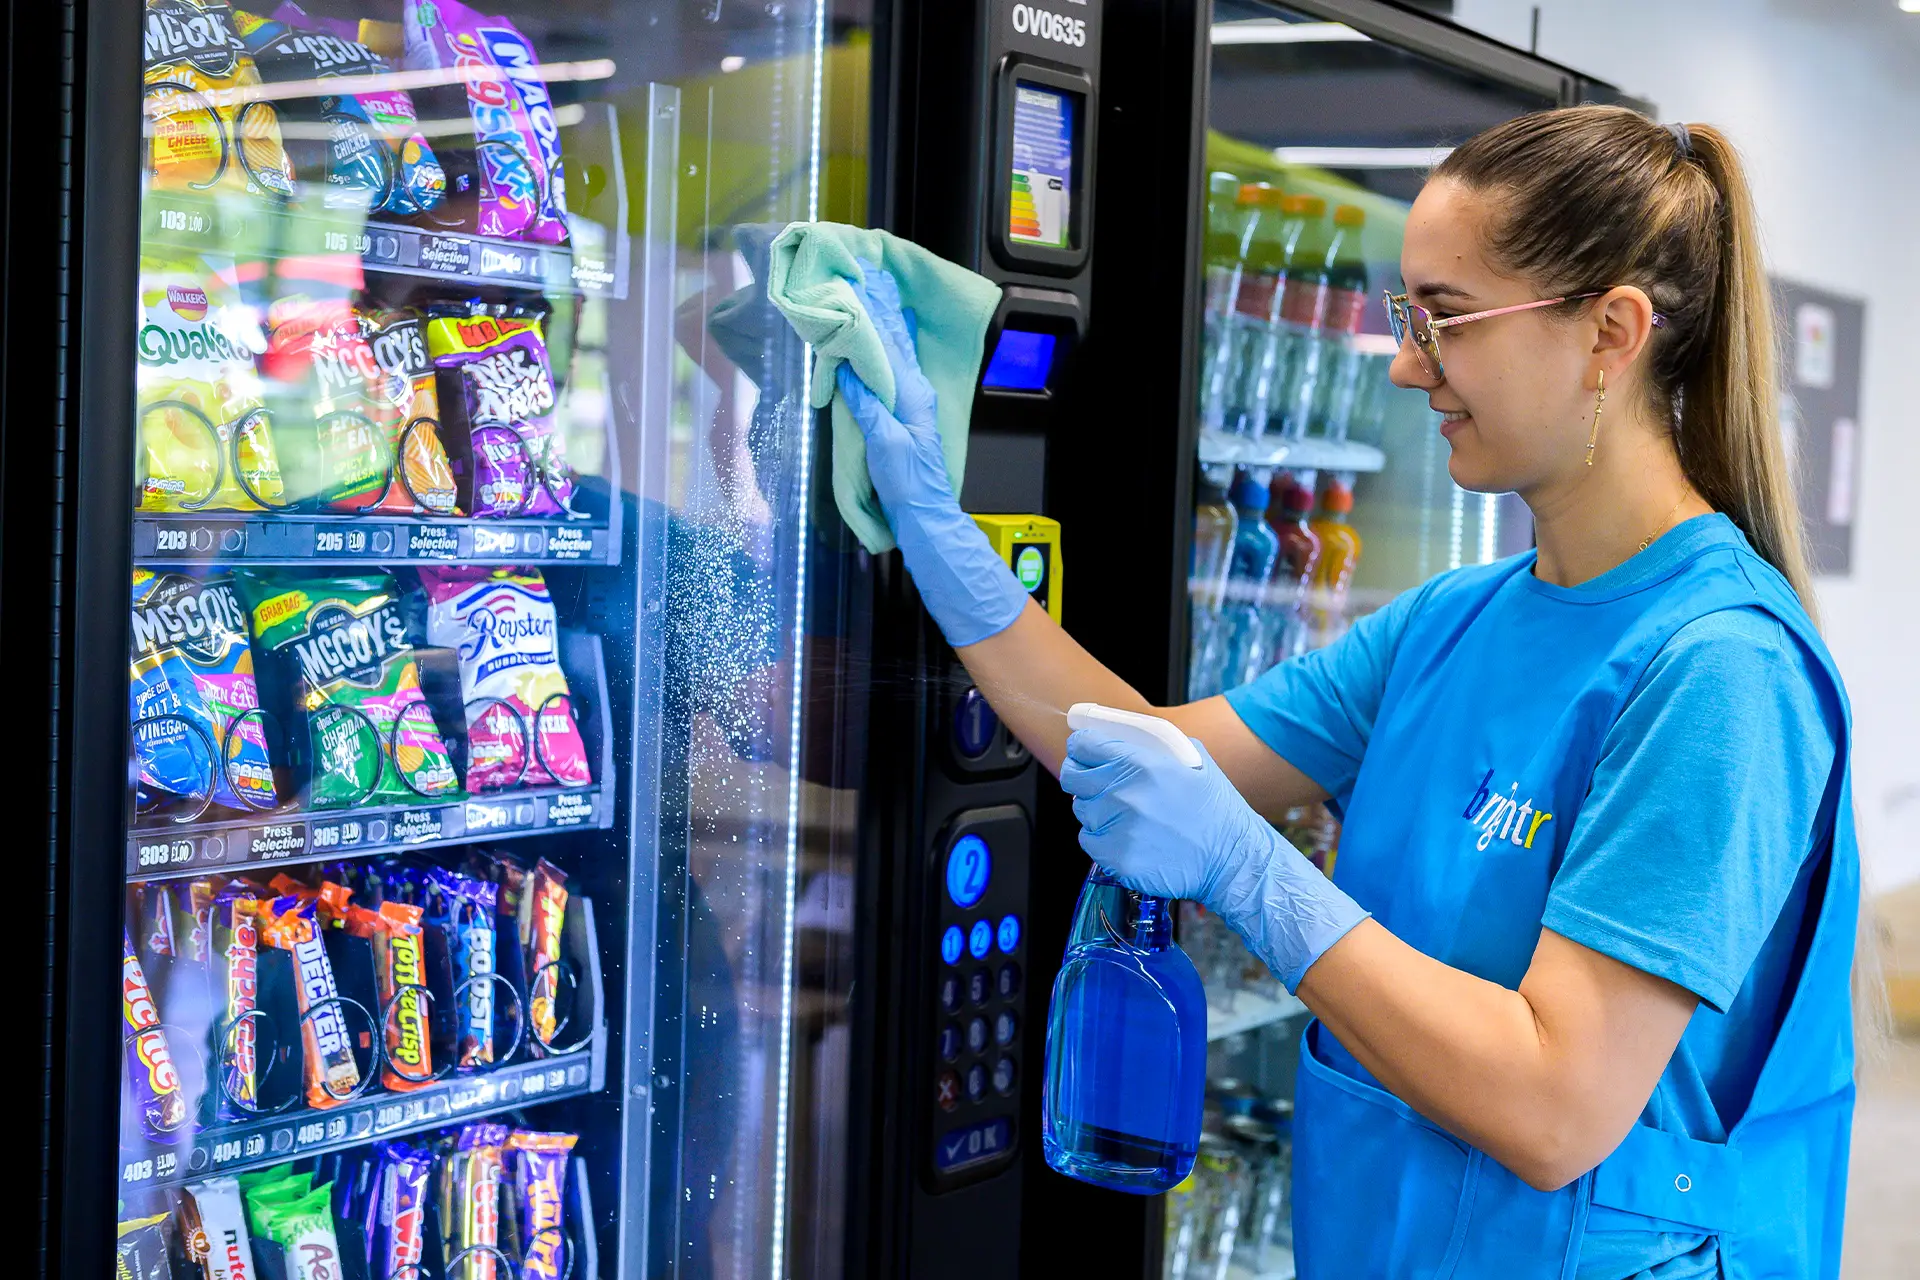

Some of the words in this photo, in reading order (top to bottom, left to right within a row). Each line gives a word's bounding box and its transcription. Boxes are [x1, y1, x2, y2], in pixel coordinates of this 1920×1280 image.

[1010, 3, 1078, 43] OV0635
[168, 133, 207, 148] CHEESE
[329, 120, 359, 142] SWEET
[333, 132, 371, 160] CHICKEN
[160, 209, 186, 231] 103
[325, 232, 348, 251] 105
[431, 237, 459, 251] Press
[421, 246, 470, 265] Selection
[430, 262, 441, 271] for
[440, 263, 457, 273] Price
[167, 290, 207, 305] WALKERS
[158, 531, 187, 550] 203
[317, 532, 343, 551] 205
[420, 526, 447, 538] Press
[557, 527, 583, 539] Press
[410, 536, 458, 550] Selection
[548, 538, 593, 551] Selection
[159, 586, 177, 599] THE
[260, 603, 283, 622] GRAB
[283, 594, 301, 613] BAG
[316, 620, 329, 631] THE
[329, 613, 346, 626] REAL
[136, 686, 156, 705] RIDGE
[156, 680, 170, 696] CUT
[139, 697, 168, 719] SALT
[172, 693, 182, 708] &
[321, 715, 366, 752] CHEDDAR
[558, 795, 583, 806] Press
[1462, 768, 1552, 851] brightr
[403, 811, 431, 822] Press
[548, 804, 593, 819] Selection
[263, 826, 293, 839] Press
[313, 827, 339, 847] 305
[393, 820, 442, 837] Selection
[251, 835, 305, 854] Selection
[140, 844, 169, 866] 303
[262, 851, 272, 860] for
[272, 850, 290, 859] Price
[963, 849, 980, 894] 2
[975, 928, 984, 951] 2
[1002, 923, 1011, 946] 3
[295, 940, 342, 1057] DECKER
[377, 1106, 403, 1126] 406
[297, 1123, 324, 1143] 405
[968, 1124, 998, 1154] OK
[213, 1141, 242, 1162] 404
[123, 1160, 152, 1182] 403
